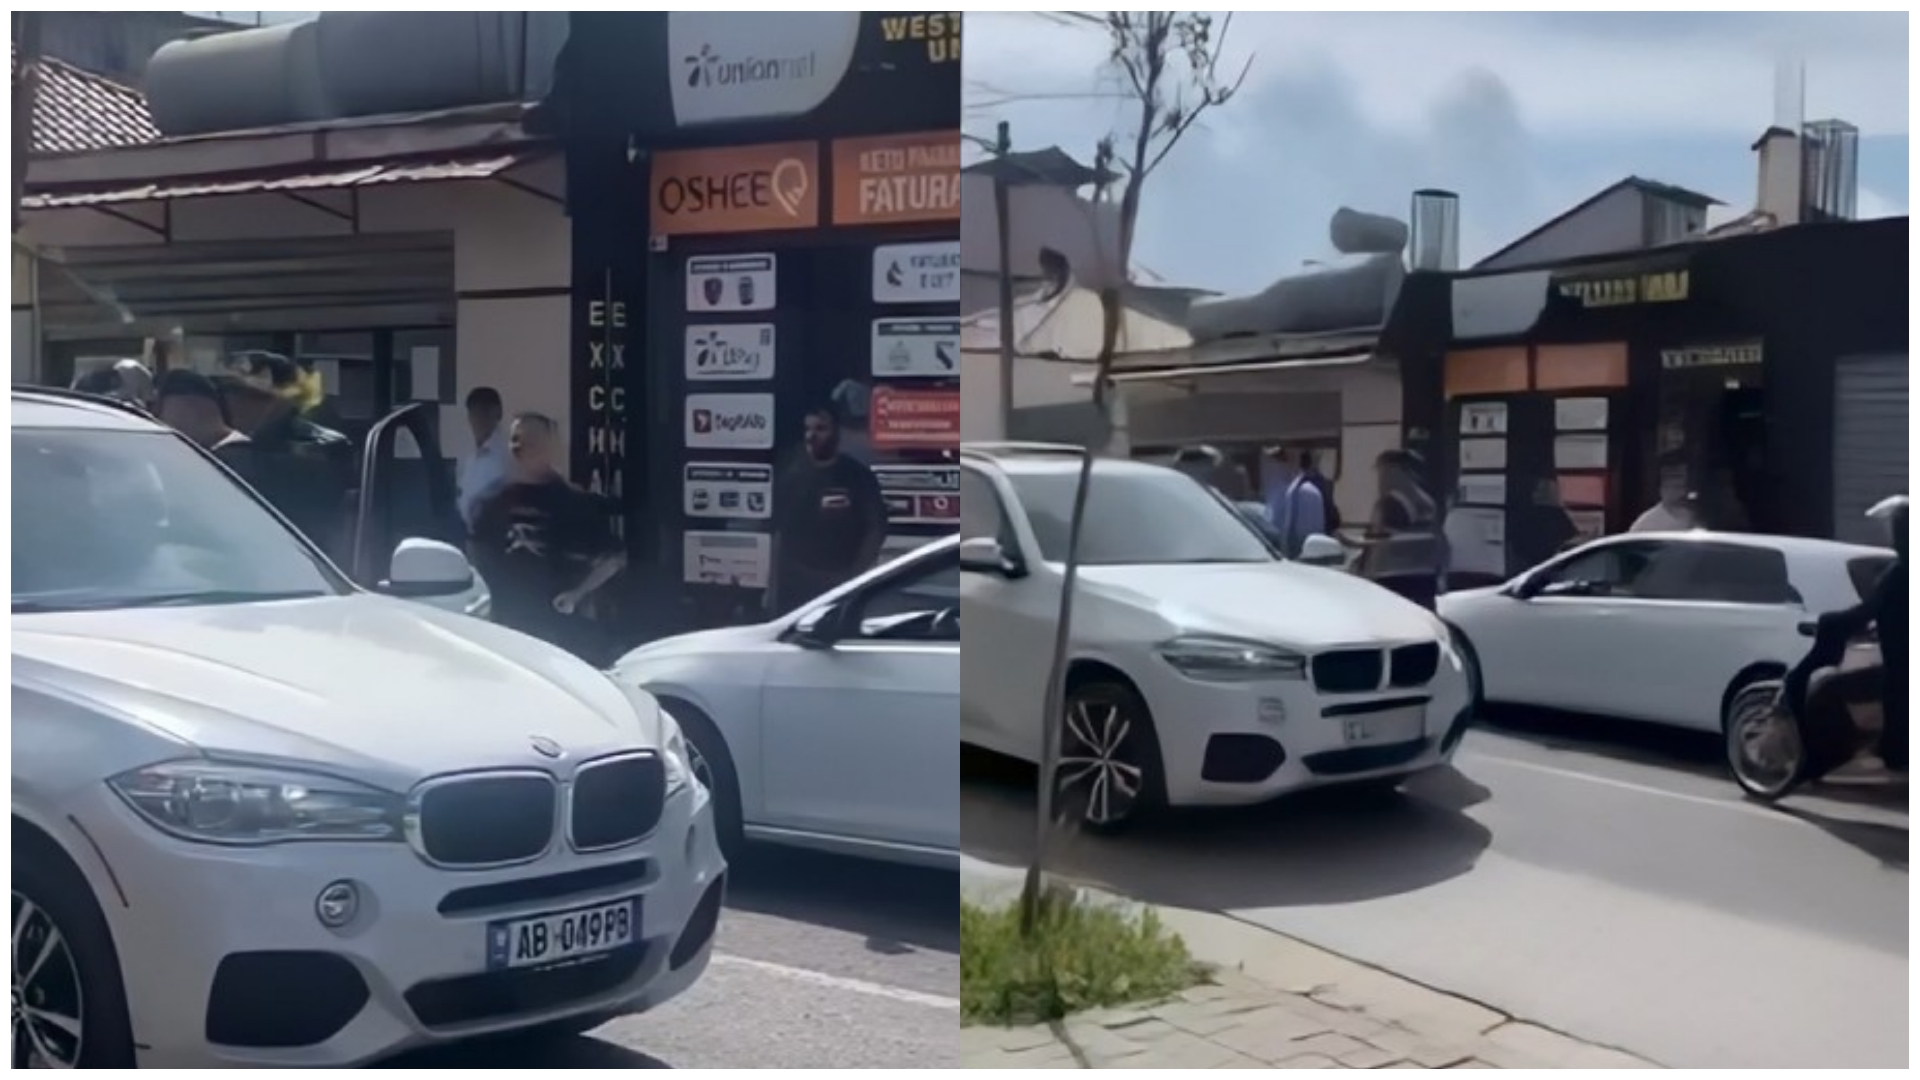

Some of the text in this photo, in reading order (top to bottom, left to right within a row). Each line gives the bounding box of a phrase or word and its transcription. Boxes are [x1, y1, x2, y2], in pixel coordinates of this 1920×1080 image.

[659, 171, 771, 215] OSHEE
[517, 907, 629, 958] AB 049PB
